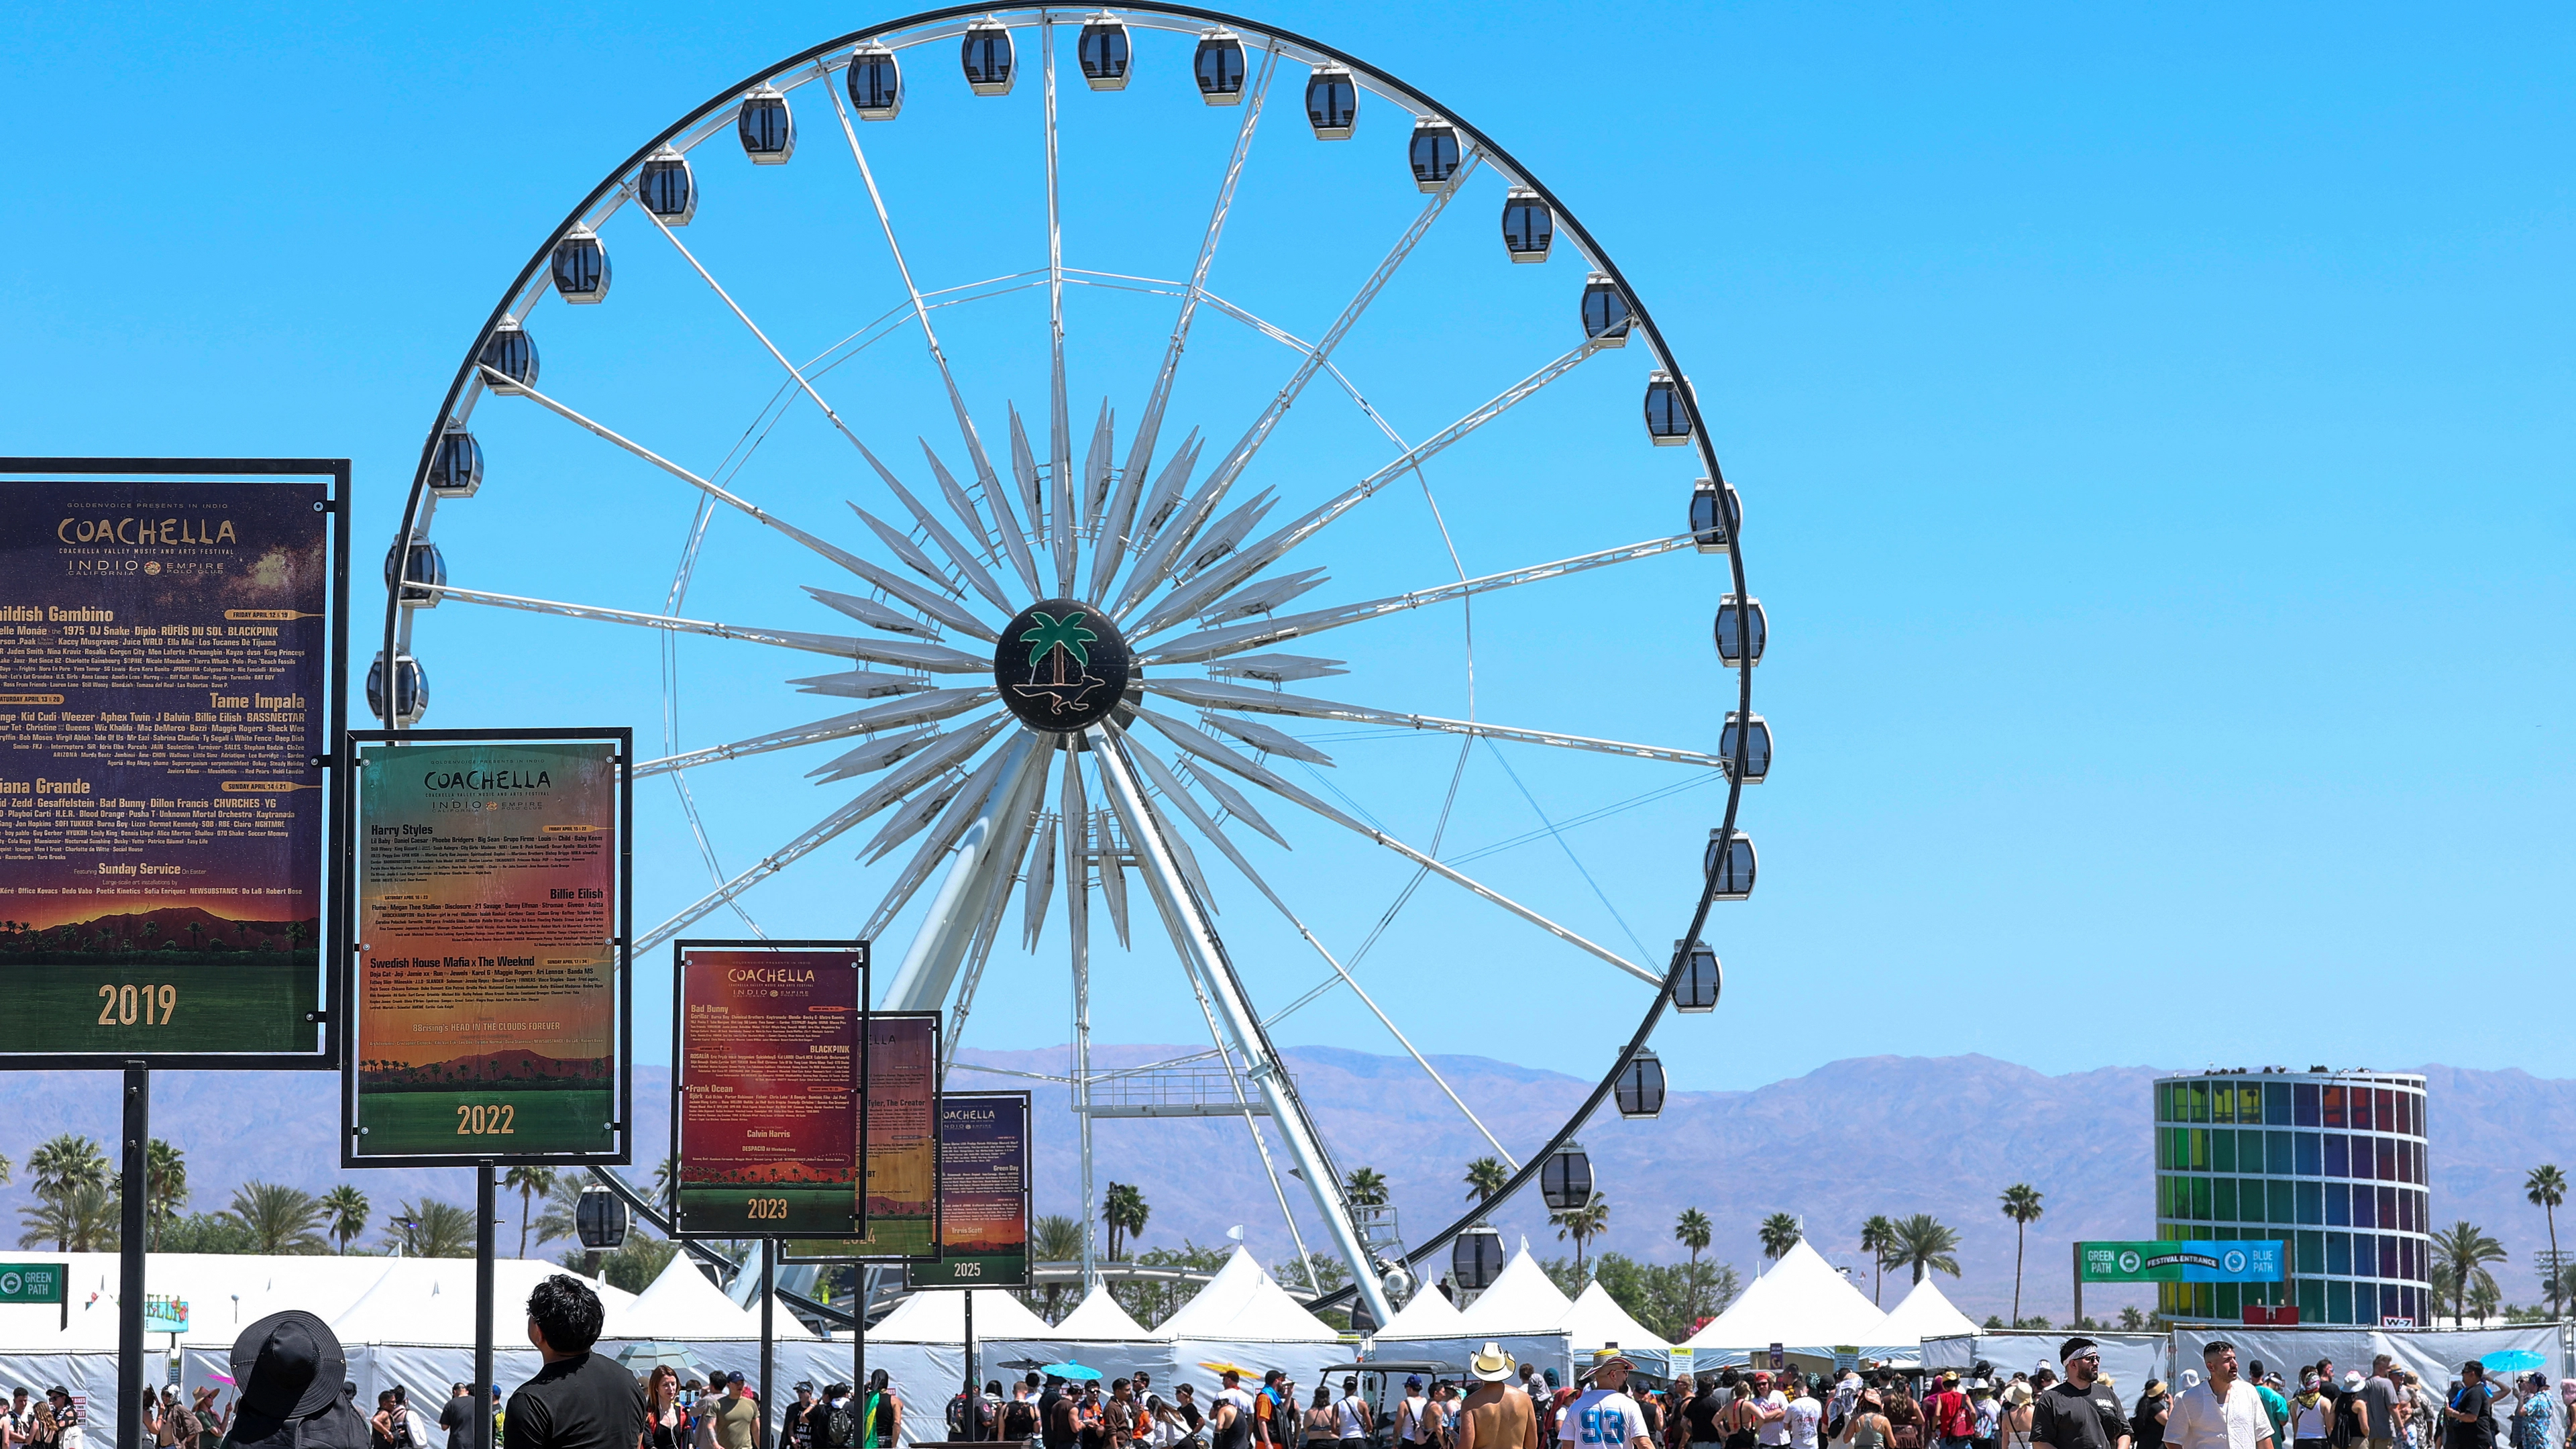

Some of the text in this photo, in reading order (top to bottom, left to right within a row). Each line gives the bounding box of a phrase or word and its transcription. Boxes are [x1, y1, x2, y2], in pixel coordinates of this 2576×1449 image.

[58, 518, 236, 545] COACHELLA
[69, 560, 138, 571] INDIO
[49, 606, 113, 622] Gambino
[17, 625, 47, 635] Monáe
[63, 626, 85, 635] 1975
[90, 626, 101, 635] DJ
[103, 626, 130, 635] Snake
[135, 626, 156, 637] Diplo
[161, 625, 189, 635] RÜFÜS
[192, 627, 204, 636] DU
[206, 627, 223, 636] SOL
[228, 627, 278, 637] BLACKPINK
[209, 692, 305, 712] Tame Impala
[0, 712, 305, 723] nge Kid Cudi Weezer Aphex Twin J Balvin Billie Eilish BASSNECTAR
[36, 777, 90, 794] Grande
[424, 770, 551, 790] COACHELLA
[11, 798, 32, 808] Zedd
[38, 798, 95, 808] Gesaffelstein
[100, 798, 116, 808] Bad
[119, 798, 146, 810] Bunny
[150, 798, 174, 808] Dillon
[177, 798, 209, 808] Francis
[213, 798, 260, 808] CHVRCHES
[264, 798, 276, 808] YG
[433, 801, 482, 809] INDIO
[371, 824, 433, 837] Harry Styles
[452, 837, 474, 845] Bridgers
[99, 863, 137, 877] Sunday
[140, 863, 181, 875] Service
[550, 888, 603, 900] Billie Eilish
[370, 957, 409, 969] Swedish
[412, 957, 440, 968] House
[443, 957, 470, 967] Mafia
[478, 956, 494, 967] The
[497, 956, 535, 967] Weeknd
[728, 969, 815, 983] COACHELLA
[98, 984, 177, 1026] 2019
[707, 1005, 729, 1014] Bunny
[413, 1022, 560, 1033] 88rising's HEAD IN THE CLOUDS FOREVER
[810, 1045, 850, 1054] BLACKPINK
[690, 1085, 733, 1093] Frank Ocean
[868, 1099, 885, 1108] Tyler,
[457, 1105, 515, 1134] 2022
[943, 1110, 996, 1120] OACHELLA
[747, 1130, 790, 1138] Calvin Harris
[748, 1198, 788, 1220] 2023
[2088, 1250, 2114, 1261] GREEN
[2253, 1250, 2273, 1260] BLUE
[2147, 1255, 2216, 1267] FESTIVAL ENTRANCE
[954, 1263, 981, 1277] 2025
[2091, 1263, 2112, 1273] PATH
[2253, 1262, 2273, 1273] PATH
[25, 1272, 52, 1283] GREEN
[28, 1284, 48, 1295] PATH
[2386, 1318, 2411, 1327] W-7
[1580, 1407, 1625, 1445] 93
